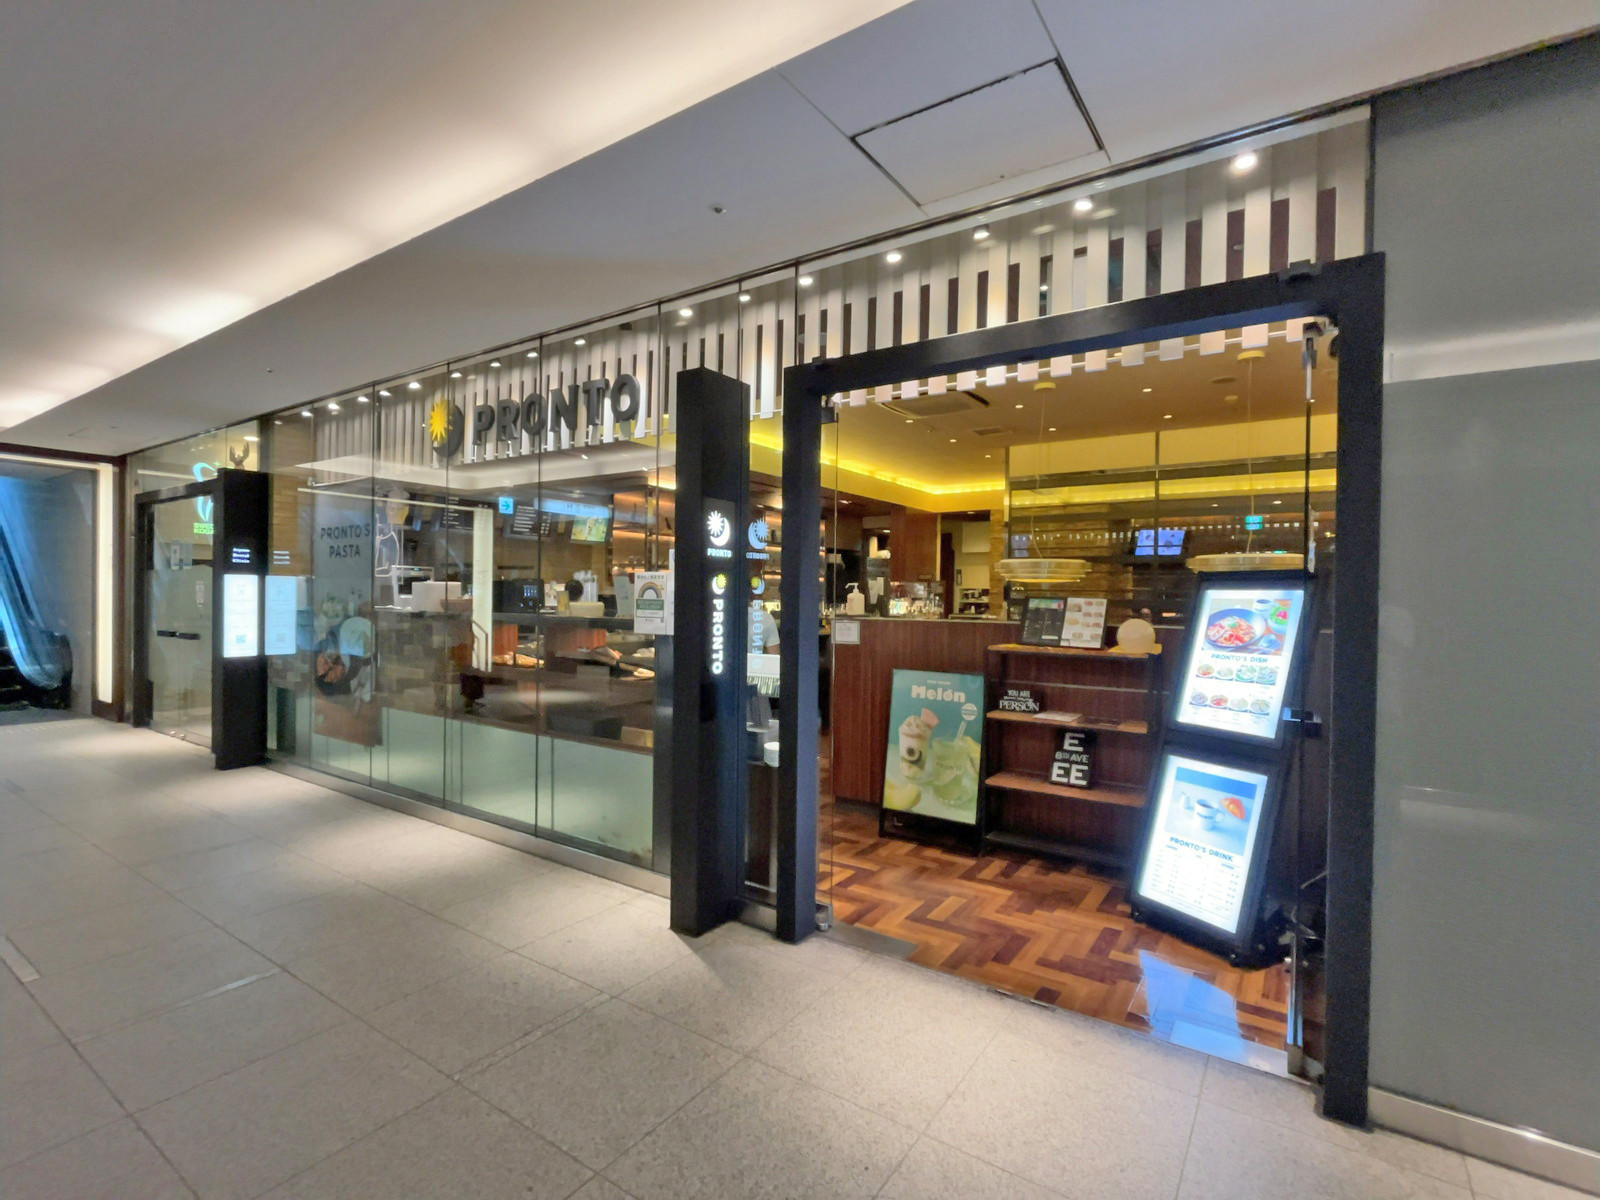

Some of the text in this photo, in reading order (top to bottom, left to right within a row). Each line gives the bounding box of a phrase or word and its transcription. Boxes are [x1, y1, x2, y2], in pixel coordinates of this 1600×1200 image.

[472, 373, 640, 446] PRONTO
[320, 523, 370, 540] PRONTOS
[329, 544, 361, 558] PASTA
[707, 548, 732, 558] PRONTO
[712, 599, 724, 674] PRONTO
[1211, 653, 1247, 662] PRONTO'S
[1000, 700, 1040, 712] PERSON
[1063, 732, 1086, 752] E
[1070, 753, 1089, 763] AVE
[1170, 836, 1234, 862] PRONTO'S DRINK
